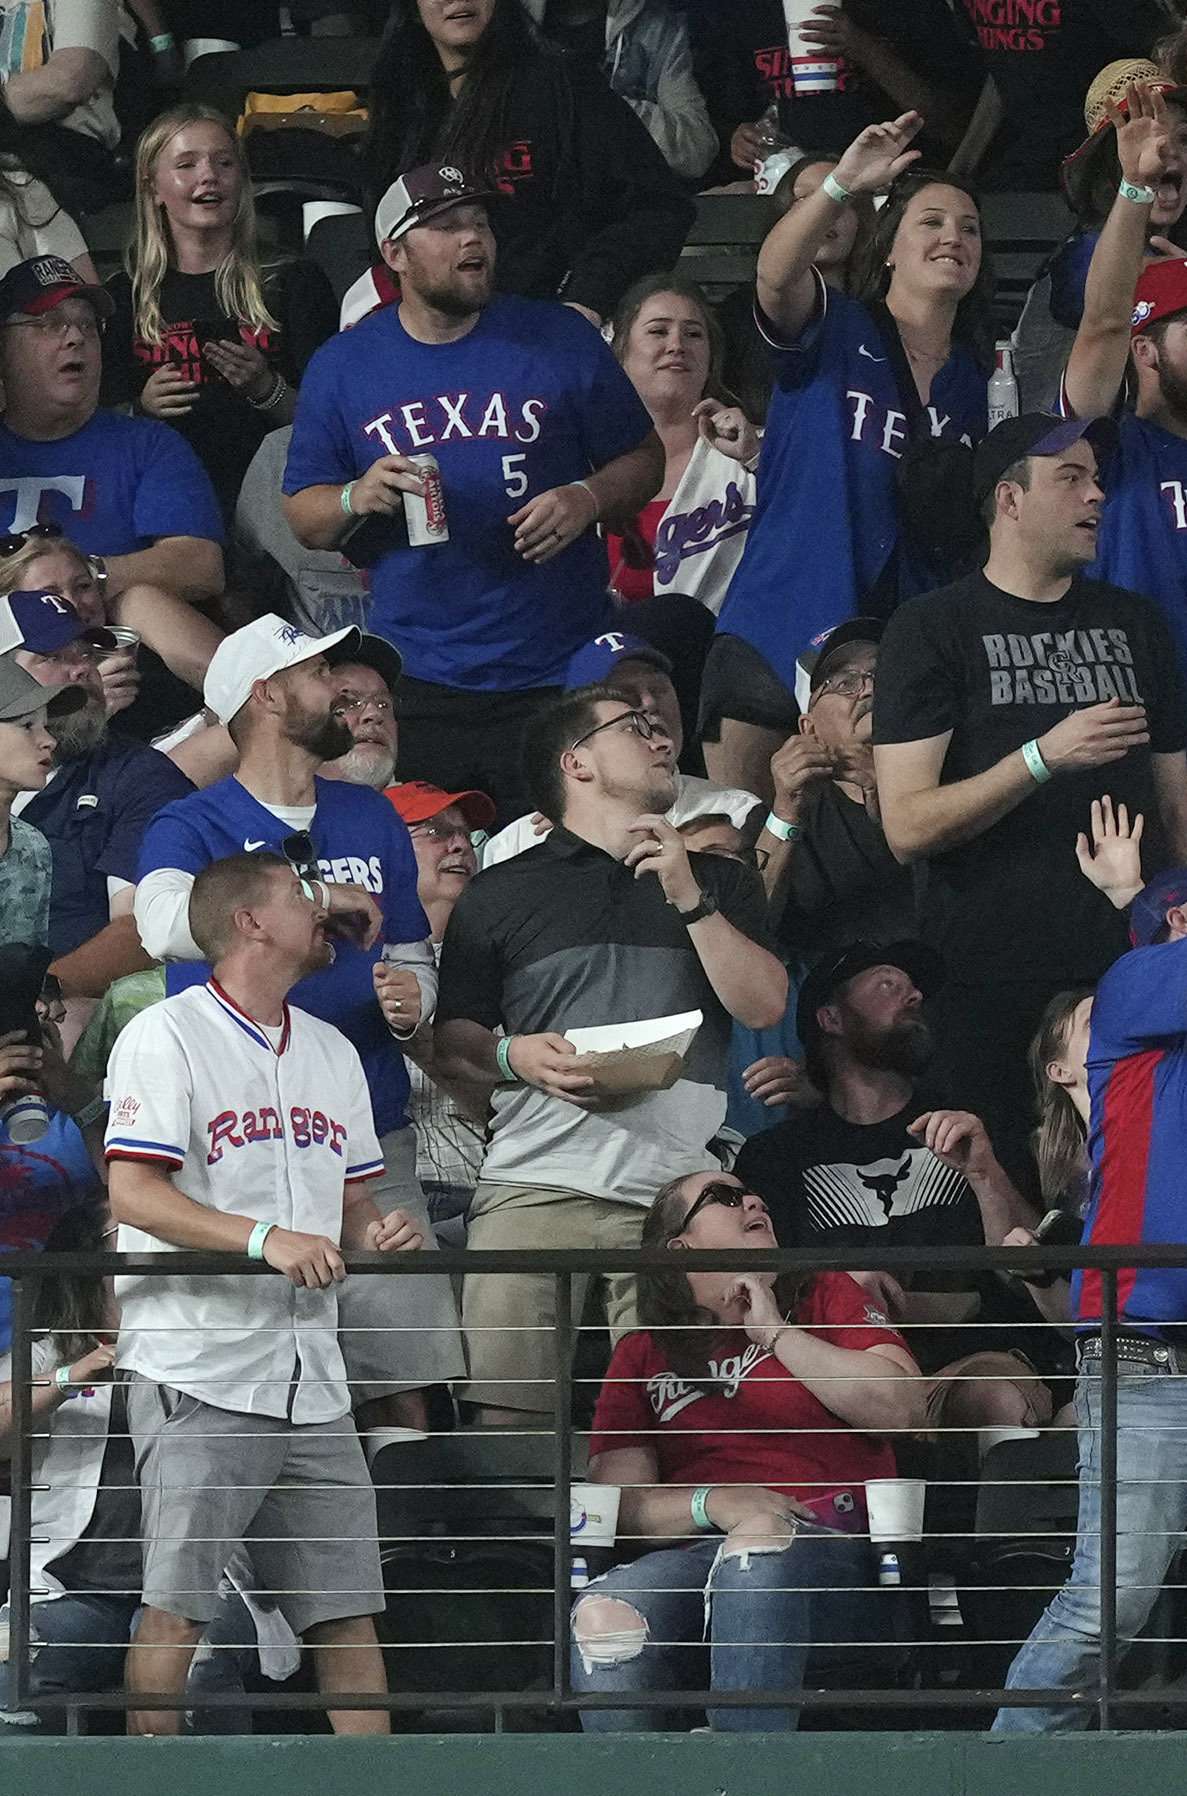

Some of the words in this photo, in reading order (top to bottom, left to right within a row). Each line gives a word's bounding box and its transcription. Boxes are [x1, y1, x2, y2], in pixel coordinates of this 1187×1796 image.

[364, 393, 545, 455] TEXAS
[502, 453, 528, 498] 5
[40, 594, 68, 614] T
[594, 632, 624, 653] T
[982, 629, 1134, 668] ROCKIES
[990, 661, 1146, 706] BASEBALL
[207, 1106, 347, 1165] Ranger
[450, 1549, 456, 1559] 5
